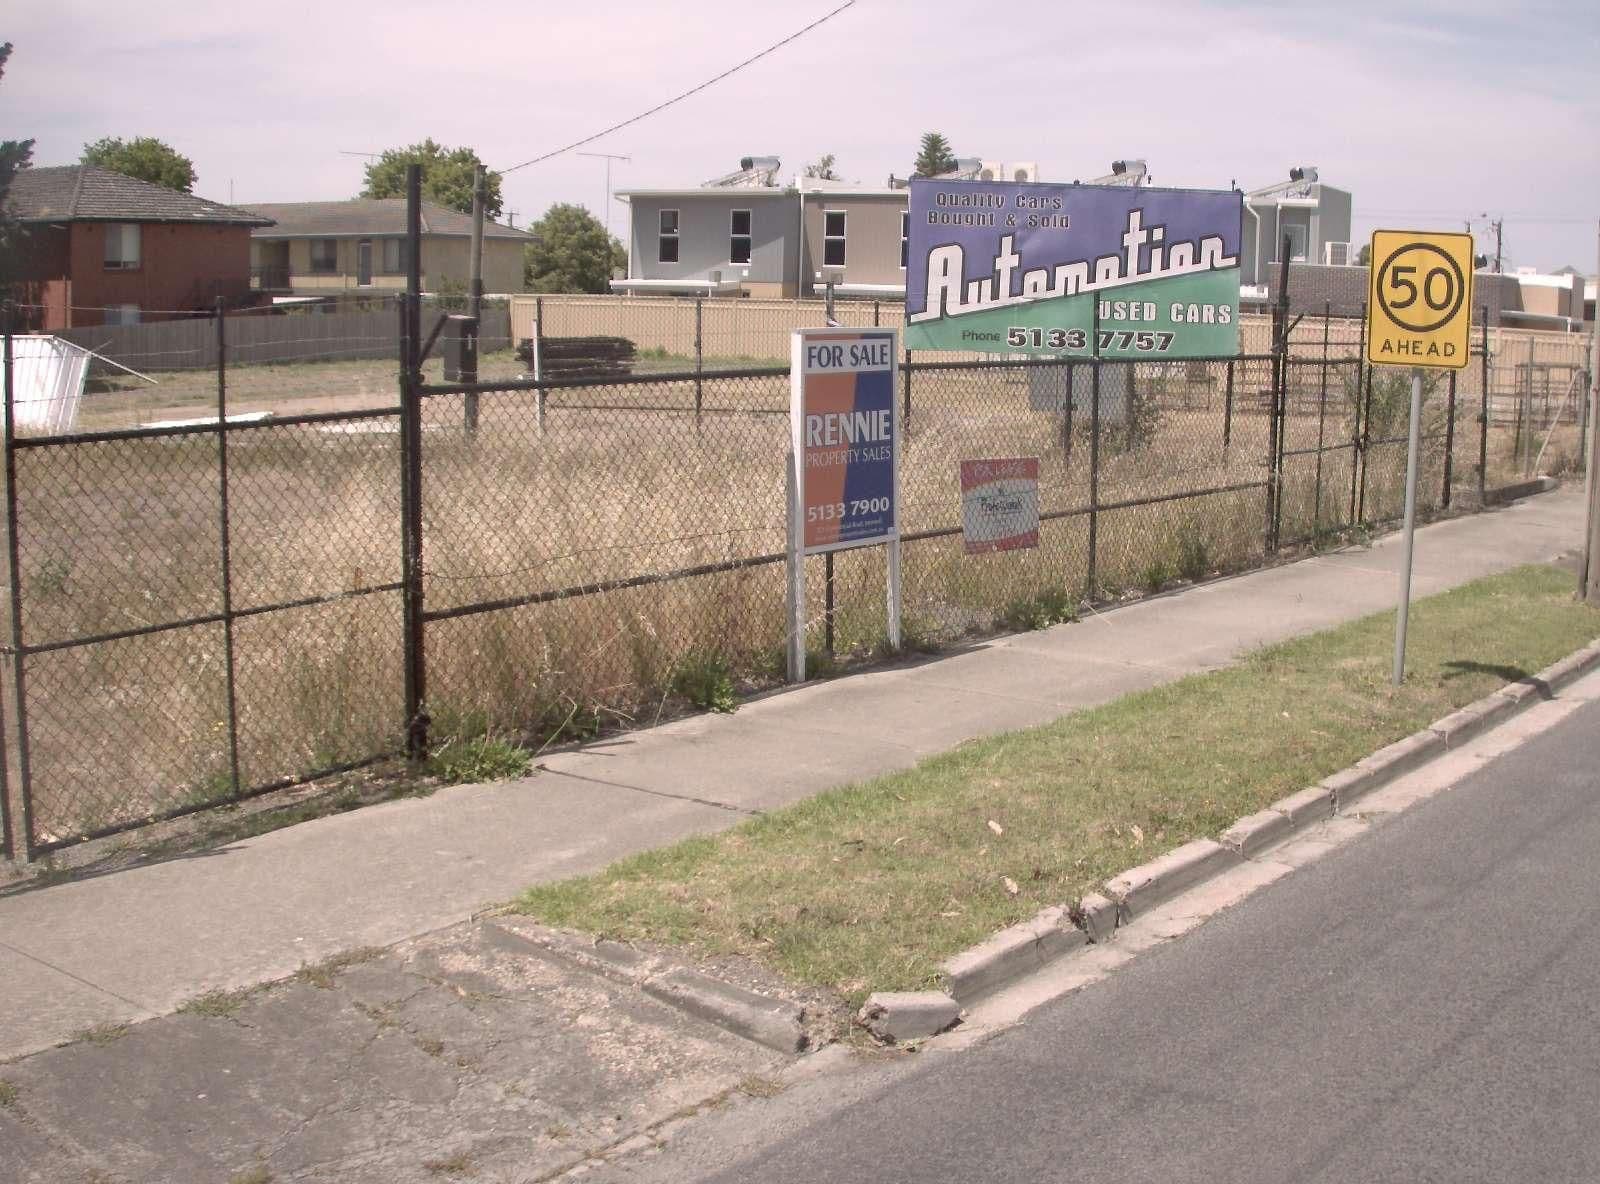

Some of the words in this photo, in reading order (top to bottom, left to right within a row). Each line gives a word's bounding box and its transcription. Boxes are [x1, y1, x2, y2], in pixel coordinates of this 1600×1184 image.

[936, 192, 1006, 209] Quality
[1015, 193, 1064, 210] Cars
[928, 210, 995, 227] Bought
[1005, 213, 1017, 228] &
[1028, 214, 1071, 229] Sold
[1389, 266, 1454, 311] 50
[1098, 300, 1157, 321] USED
[1170, 304, 1233, 324] CARS
[962, 329, 1001, 342] Phone
[1007, 327, 1087, 349] 5133
[1099, 330, 1175, 352] 7757
[1380, 338, 1457, 358] AHEAD
[807, 345, 843, 368] FOR
[849, 344, 889, 367] SALE
[806, 409, 890, 447] RENNIE
[807, 449, 859, 468] PROPERTY
[862, 447, 891, 462] SALES
[808, 502, 846, 522] 5133
[850, 496, 890, 516] 7900
